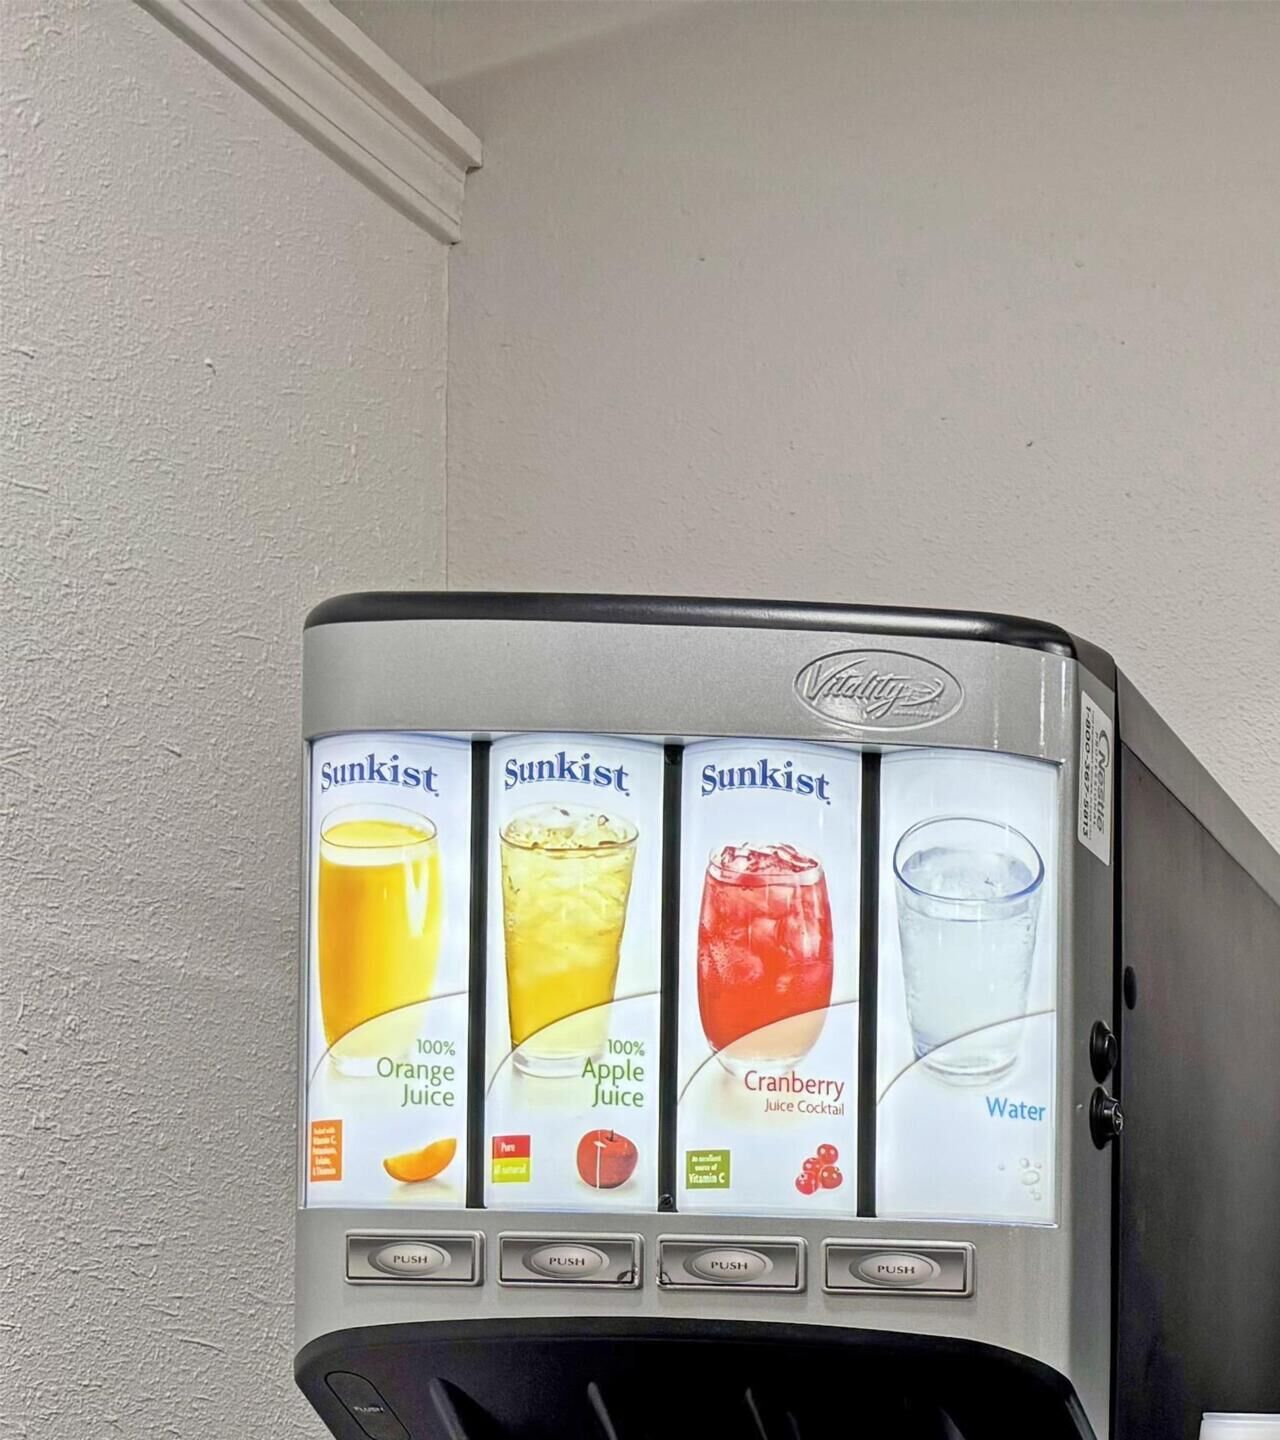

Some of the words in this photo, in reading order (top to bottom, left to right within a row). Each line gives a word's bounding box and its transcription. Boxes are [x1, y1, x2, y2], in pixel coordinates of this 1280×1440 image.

[803, 658, 912, 719] Vitality
[320, 753, 440, 796] Sunkist
[504, 751, 630, 796] Sunkist
[701, 759, 831, 804] Sunkist
[416, 1039, 456, 1056] 100%
[607, 1039, 645, 1056] 100%
[376, 1057, 455, 1085] Orange
[581, 1058, 644, 1087] Apple
[401, 1084, 455, 1108] Juice
[592, 1084, 645, 1108] Juice
[744, 1070, 845, 1102] Cranberry
[764, 1098, 794, 1113] Juice
[797, 1100, 845, 1117] Cocktail
[985, 1096, 1046, 1122] Water
[689, 1173, 717, 1184] Vitamin
[719, 1172, 725, 1183] C
[392, 1254, 428, 1266] PUSH
[548, 1256, 585, 1268] PUSH
[710, 1260, 748, 1271] PUSH
[876, 1263, 915, 1276] PUSH
